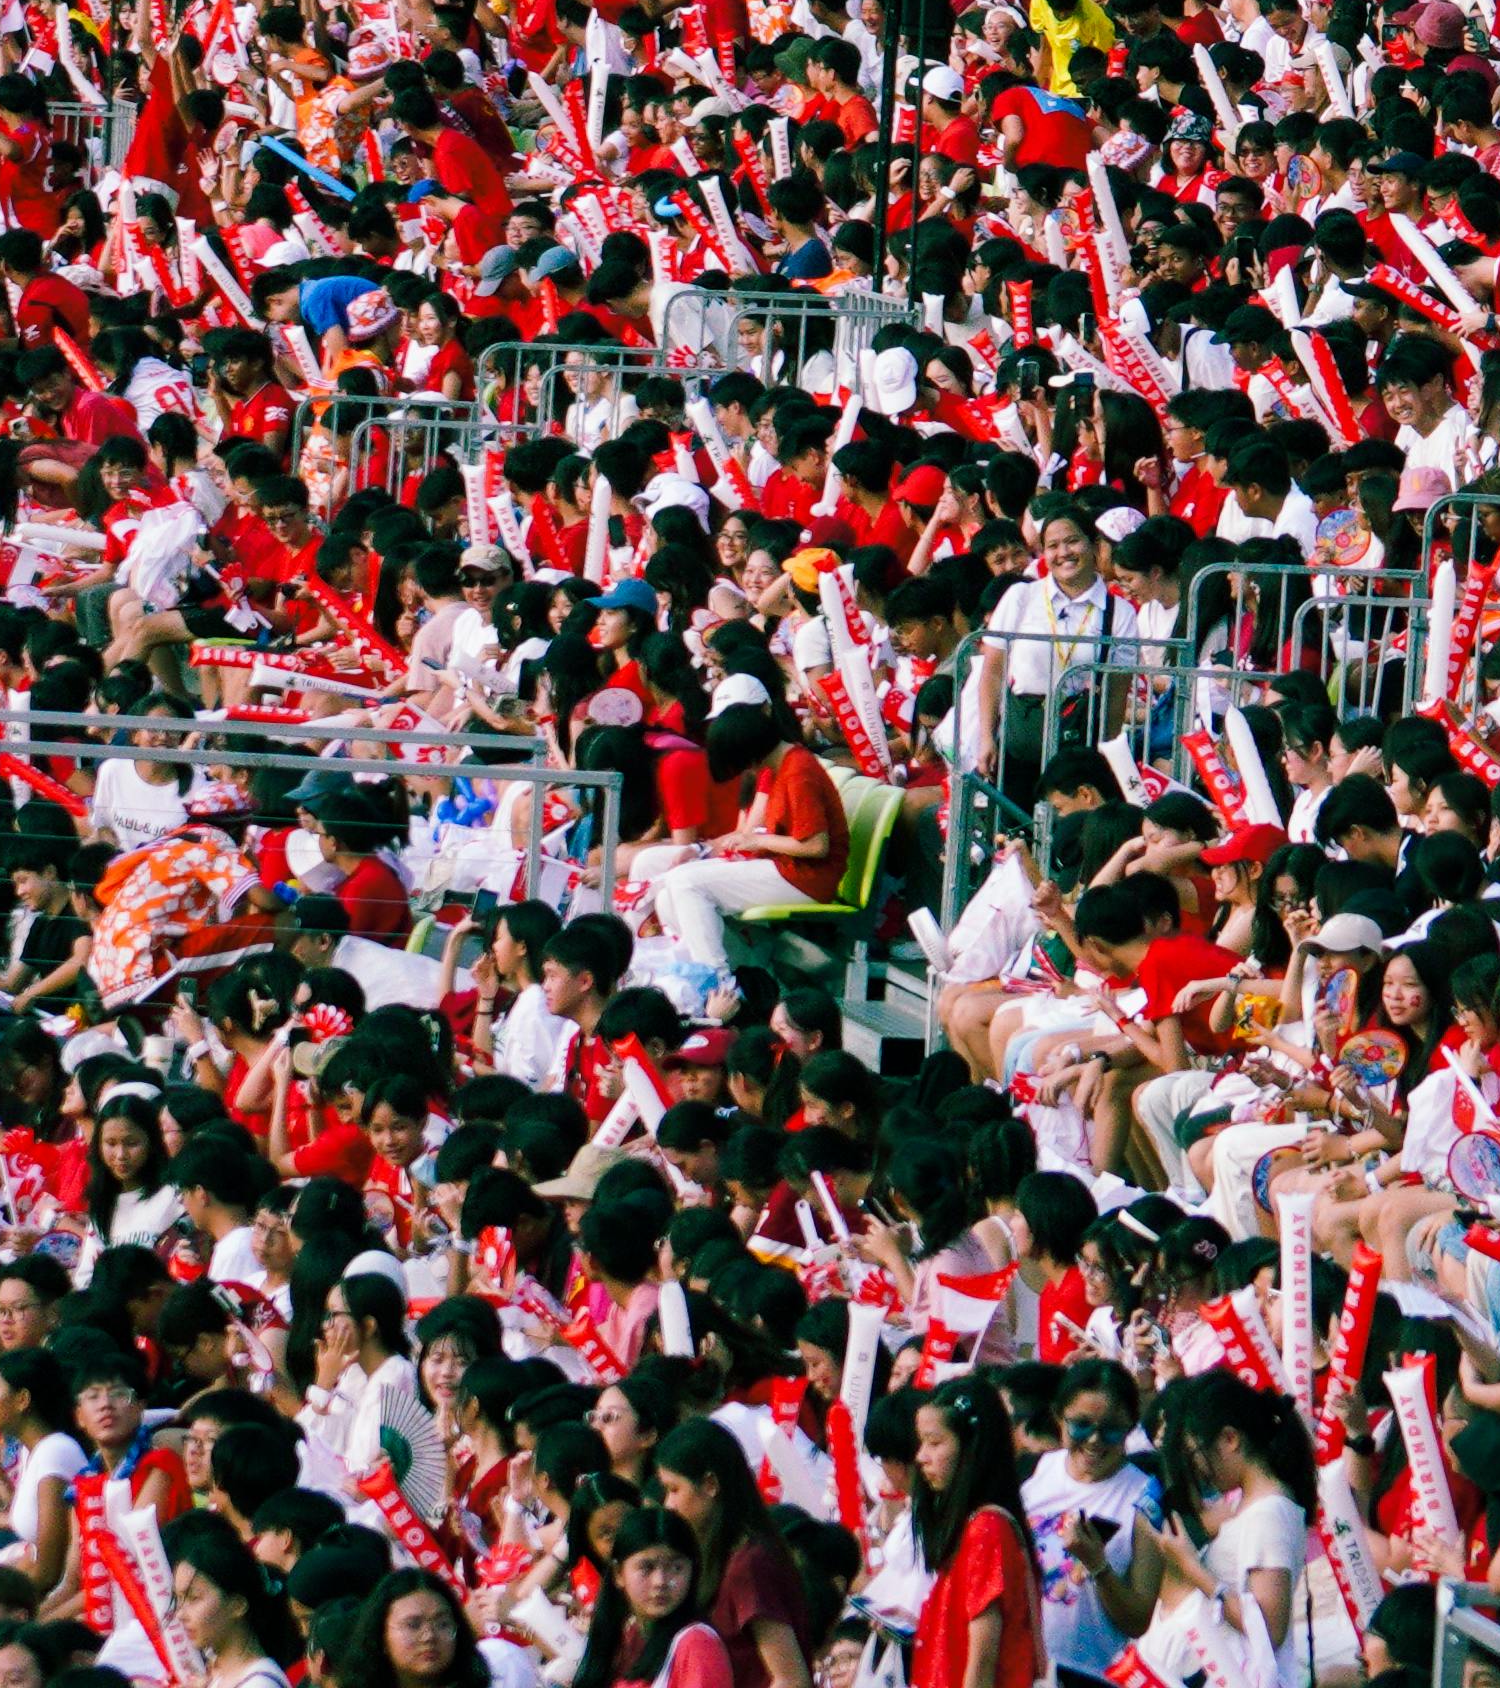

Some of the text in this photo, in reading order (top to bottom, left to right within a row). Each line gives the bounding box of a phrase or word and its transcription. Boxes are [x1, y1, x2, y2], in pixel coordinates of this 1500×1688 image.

[1015, 293, 1029, 344] SING
[832, 686, 883, 779] GAPORE
[1293, 1213, 1307, 1329] BIRTHDAY
[1399, 1396, 1444, 1512] BIRTHDAY
[136, 1528, 170, 1602] HAPPY
